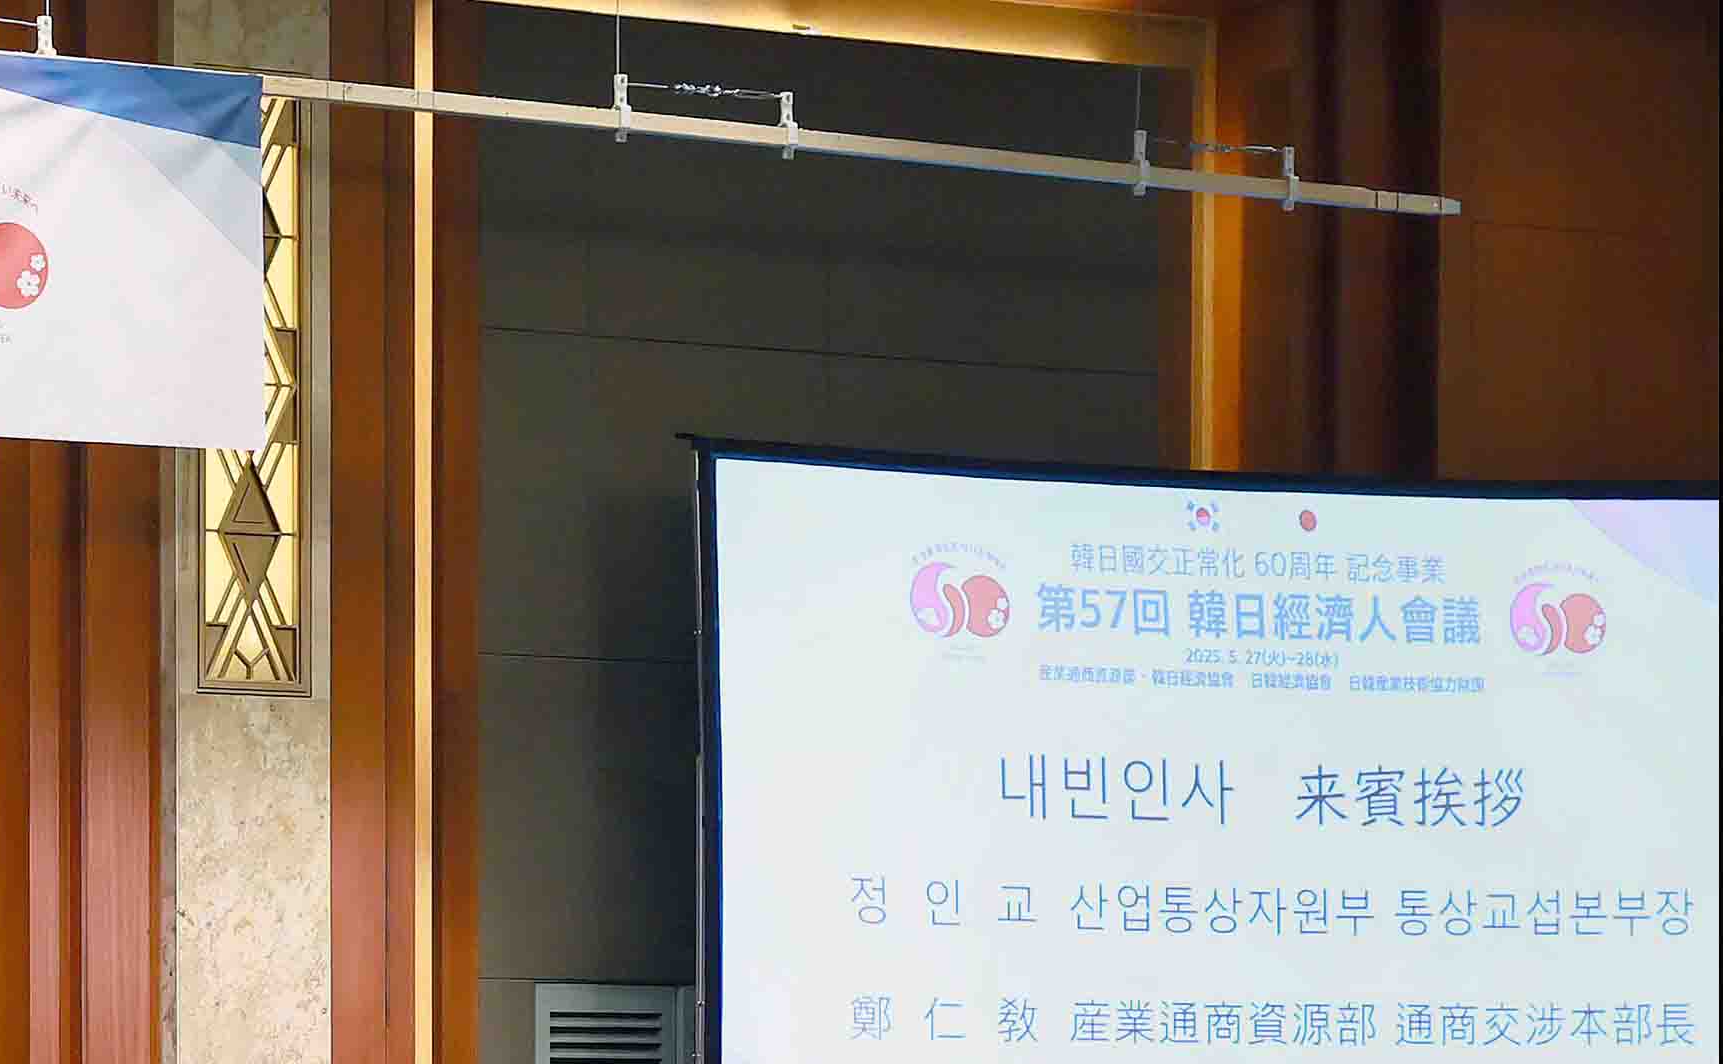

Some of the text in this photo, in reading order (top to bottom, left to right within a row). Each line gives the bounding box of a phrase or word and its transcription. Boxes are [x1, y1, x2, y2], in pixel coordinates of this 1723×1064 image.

[1071, 544, 1446, 584] 韓日國交正常化 60周年 記念事業
[1038, 584, 1480, 645] 第57回 韓日經濟人會議
[1001, 754, 1523, 826] 내빈인사 来賓挨拶
[852, 877, 1693, 936] 정 인 교 산업통상자원부 통상교섭본부장
[852, 997, 891, 1040] 鄭
[925, 998, 966, 1040] 仁
[1071, 1000, 1375, 1045] 産業通商資源部
